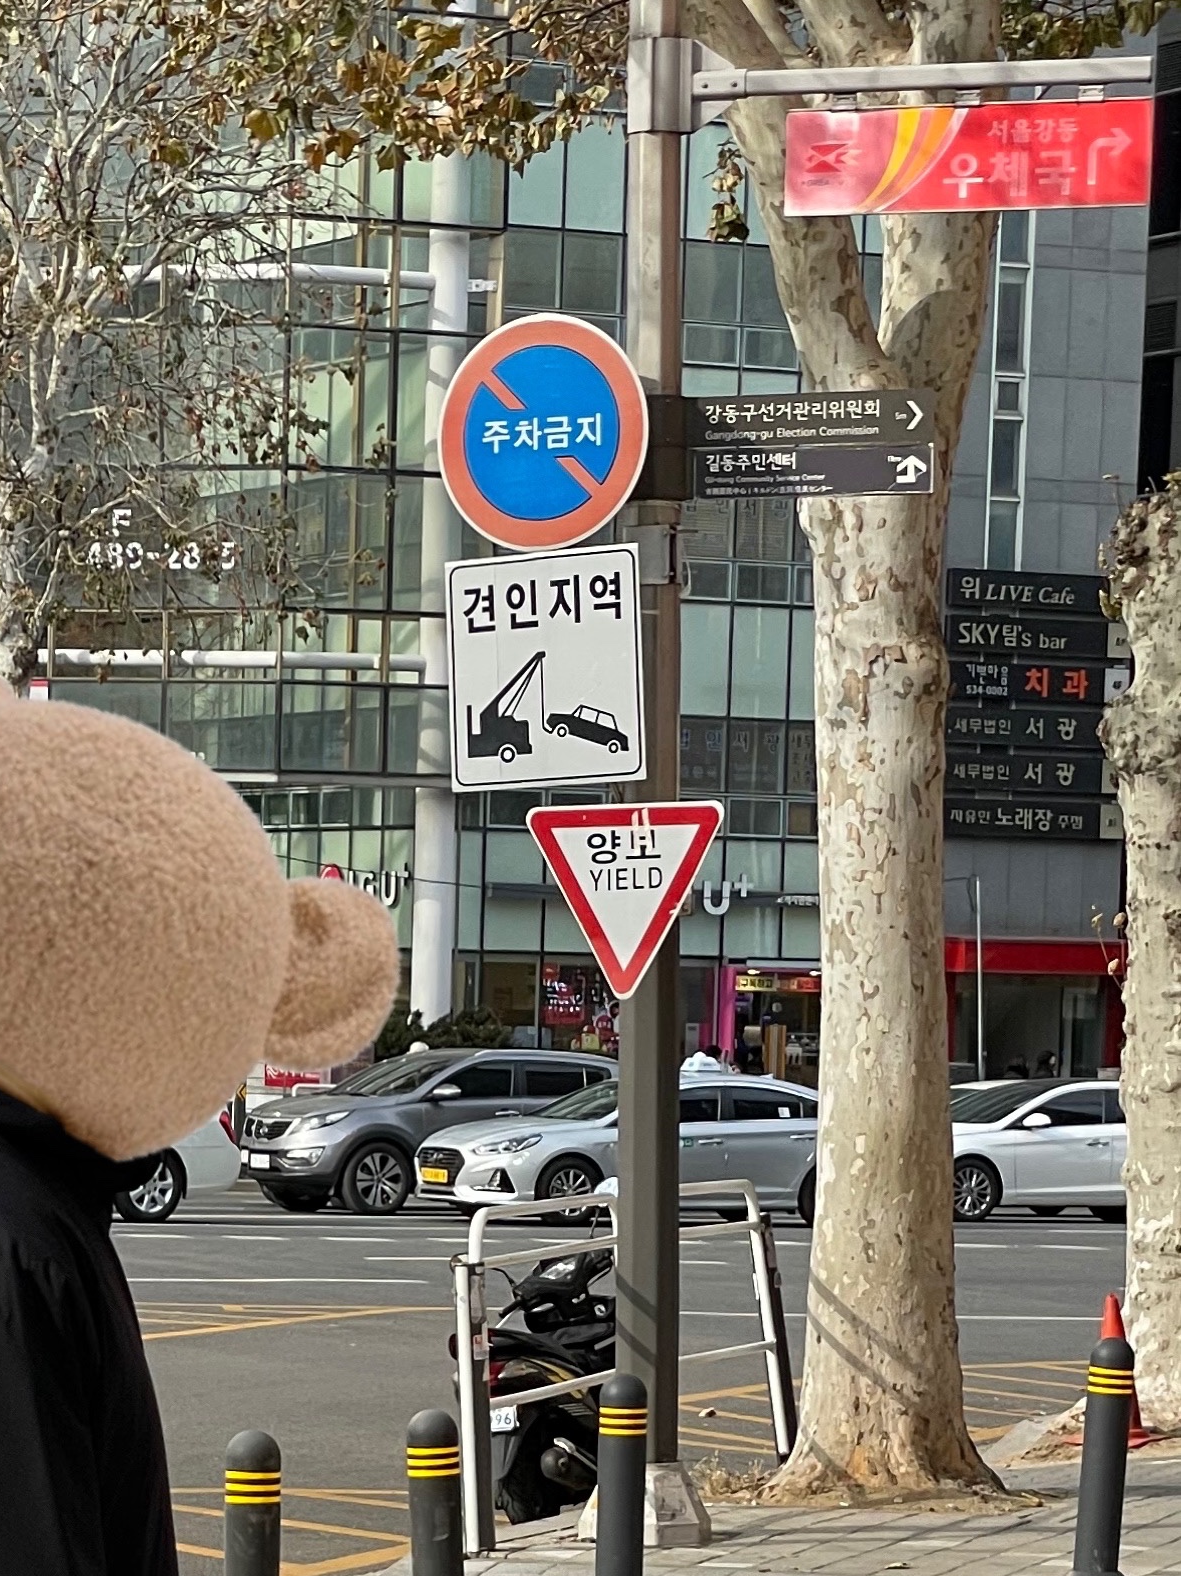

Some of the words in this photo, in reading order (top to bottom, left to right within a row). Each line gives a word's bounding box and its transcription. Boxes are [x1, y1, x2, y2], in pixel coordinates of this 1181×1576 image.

[986, 117, 1078, 144] 서울강동
[942, 150, 1077, 199] 우체국
[705, 398, 881, 424] 강동구선거관리위원회
[481, 412, 603, 455] 주차금지
[704, 429, 774, 441] Gangdong-gu
[776, 426, 817, 438] Election
[819, 424, 880, 437] Commission
[705, 451, 797, 473] 길동주민센터
[86, 541, 236, 570] 489-285
[462, 570, 622, 634] 견인지역
[959, 576, 981, 600] 위
[984, 583, 1035, 601] LIVE
[1038, 586, 1075, 605] Cafe
[1038, 633, 1068, 649] bar
[1024, 668, 1089, 699] 치과
[953, 717, 1012, 736] 세무법인
[1025, 717, 1077, 741] 서광
[952, 763, 1011, 781] 세무법인
[1023, 763, 1075, 786] 서광
[994, 807, 1054, 832] 노래장
[586, 829, 662, 865] 양보
[589, 866, 663, 892] YIELD
[702, 872, 755, 915] U+
[490, 1412, 512, 1426] 96
